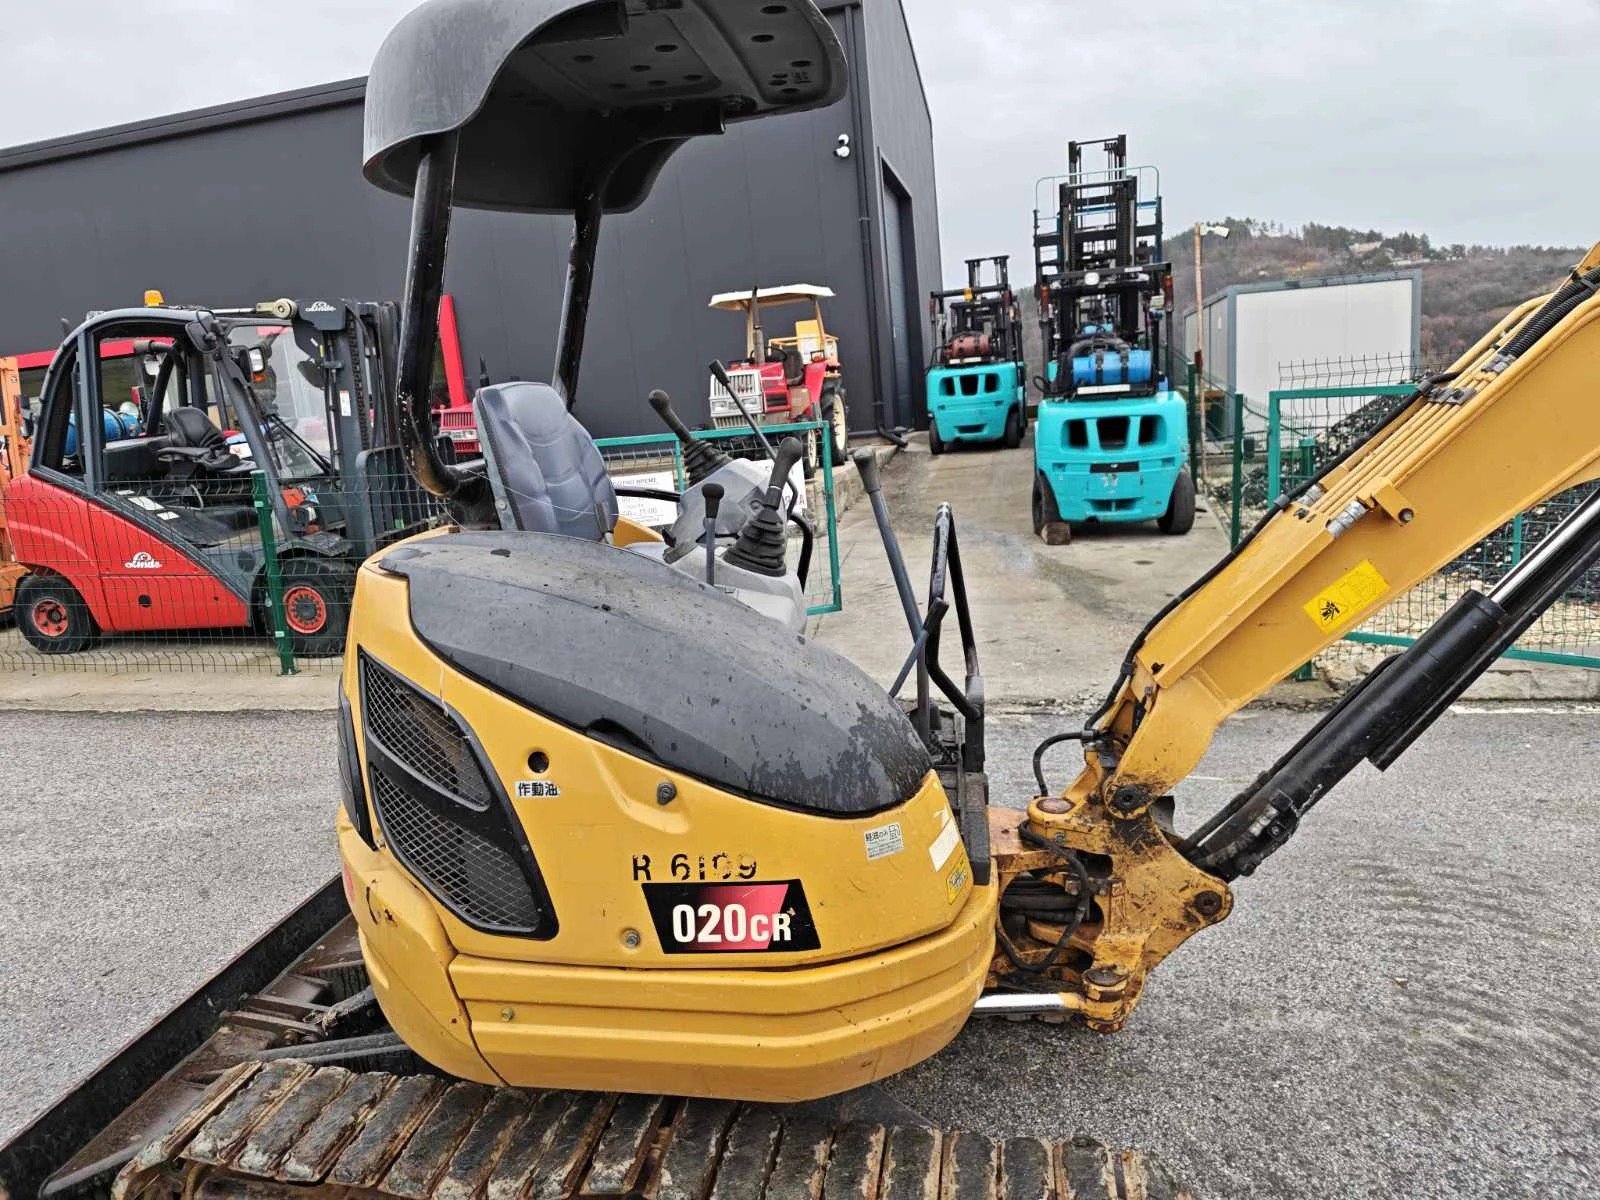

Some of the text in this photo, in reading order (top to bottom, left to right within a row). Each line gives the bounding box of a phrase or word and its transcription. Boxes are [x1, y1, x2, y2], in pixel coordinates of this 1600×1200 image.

[124, 551, 163, 568] Linde
[518, 782, 558, 797] 作動油
[672, 903, 792, 943] 020CR
